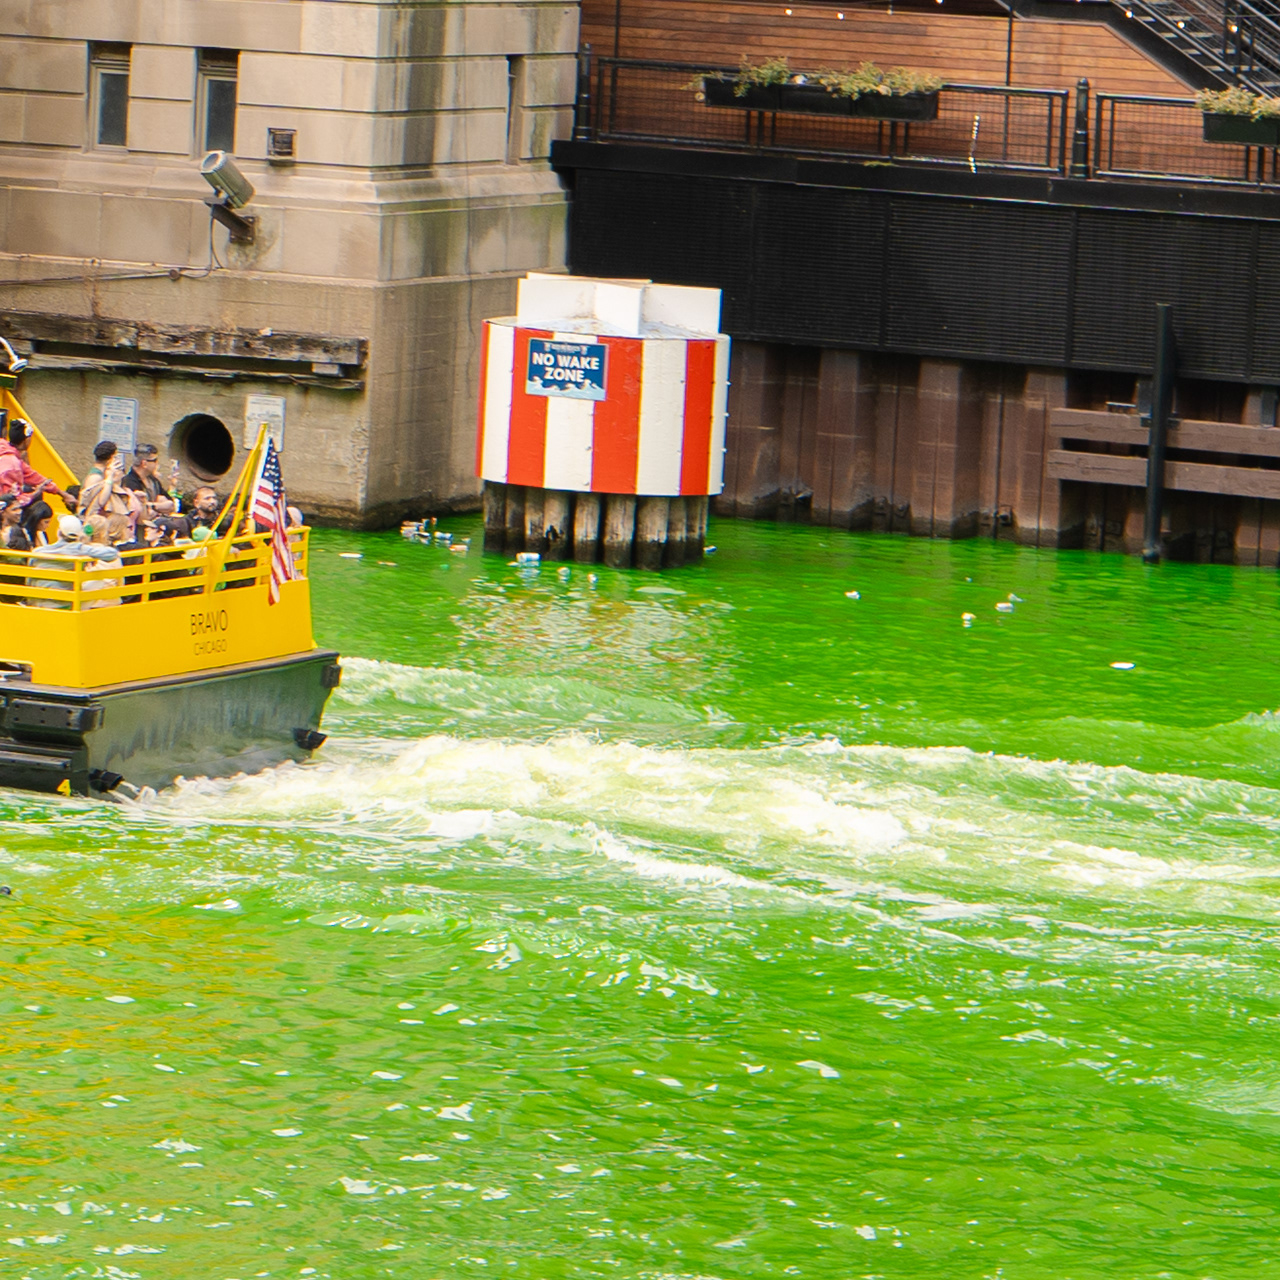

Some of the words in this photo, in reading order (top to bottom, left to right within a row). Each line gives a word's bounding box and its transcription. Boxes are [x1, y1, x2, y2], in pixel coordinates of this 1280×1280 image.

[532, 352, 555, 366] NO
[557, 354, 600, 371] WAKE
[543, 366, 585, 383] ZONE
[190, 609, 229, 636] BRAVO
[194, 638, 228, 656] CHICAGO
